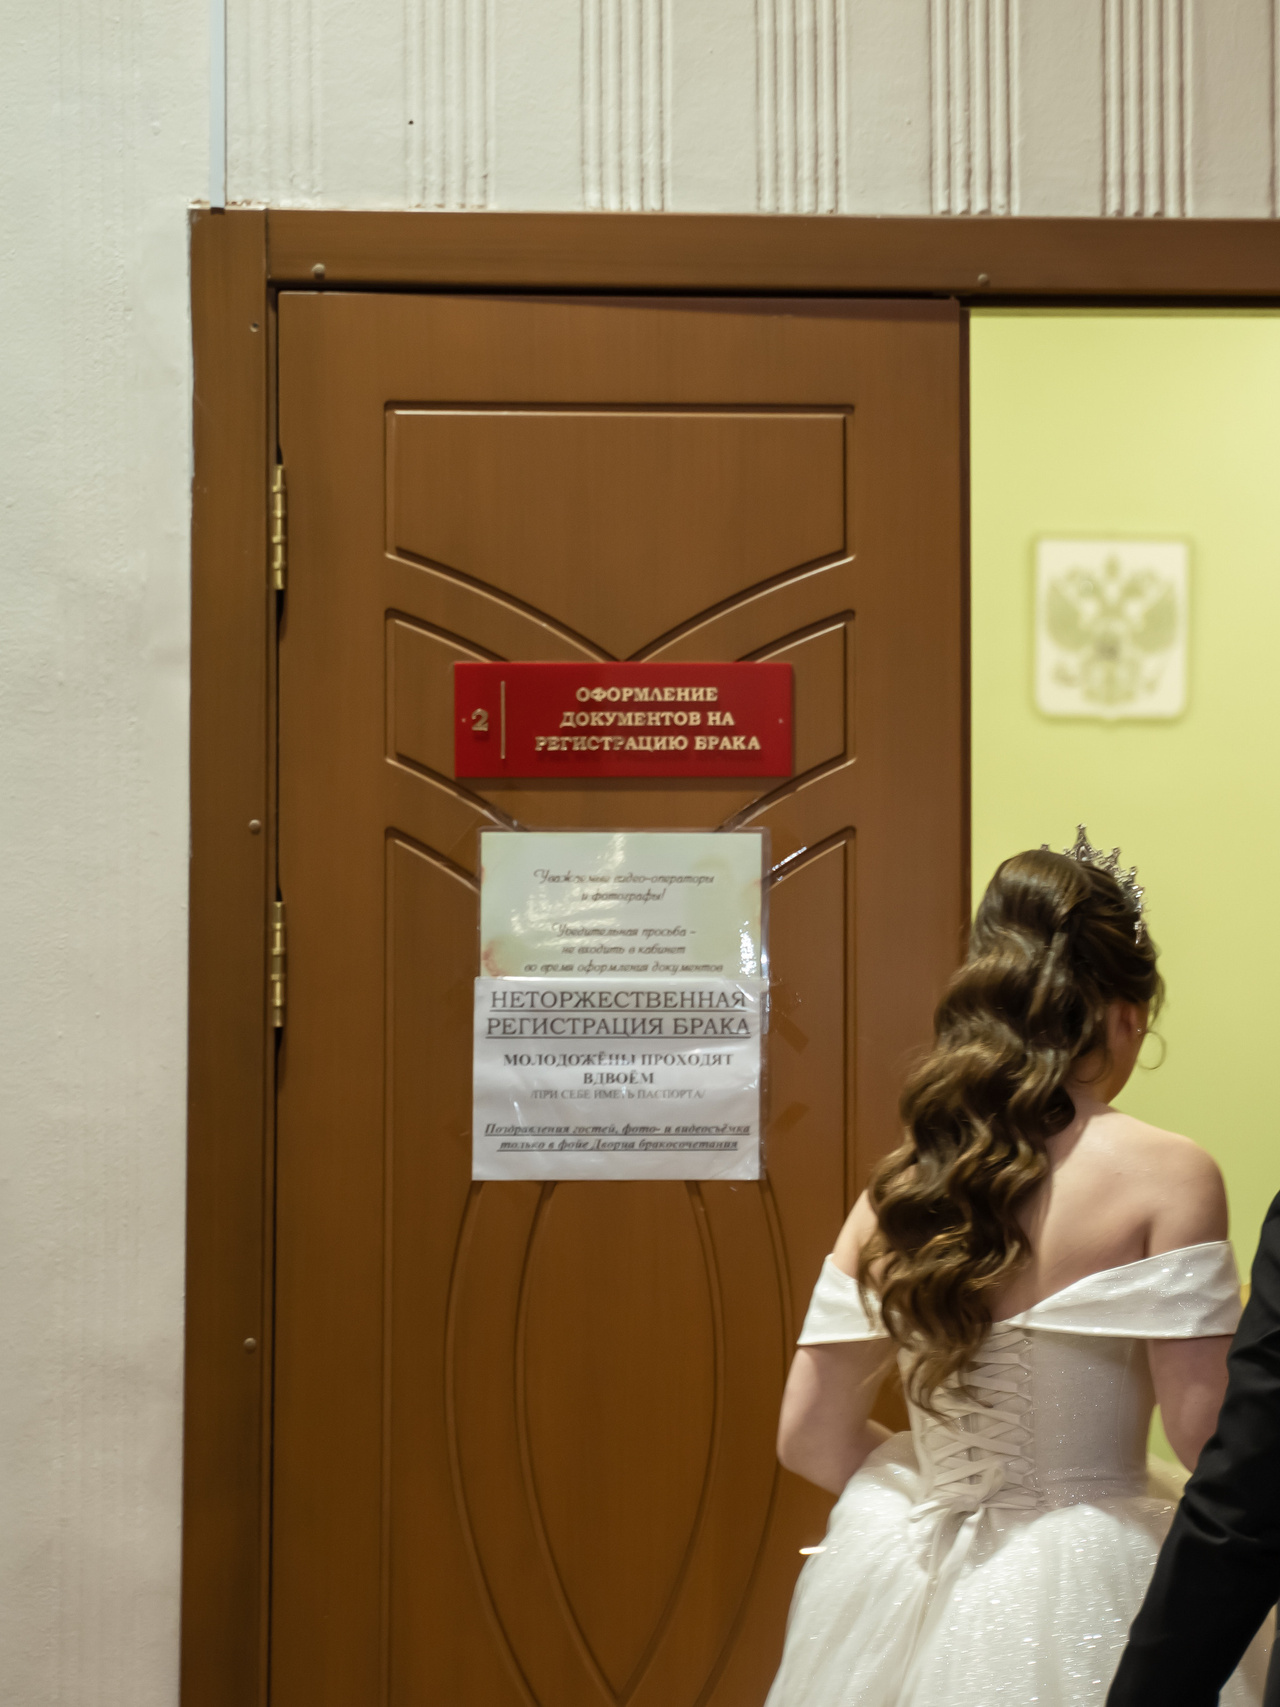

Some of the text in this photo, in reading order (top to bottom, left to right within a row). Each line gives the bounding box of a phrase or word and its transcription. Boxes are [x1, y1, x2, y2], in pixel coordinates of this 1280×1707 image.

[575, 687, 718, 702] ОФОРМЛЕНИЕ
[471, 708, 489, 732] 2
[559, 711, 735, 728] ДОКУМЕНТОВ НА
[535, 735, 761, 752] РЕГИСТРАЦИЮ БРАКА
[641, 926, 687, 939] просьба
[638, 943, 686, 954] кабинет
[651, 961, 724, 975] документов
[490, 990, 748, 1009] НЕТОРЖЕСТВЕННАЯ
[487, 1017, 751, 1036] РЕГИСТРАЦИЯ БРАКА
[641, 1053, 734, 1067] ПРОХОДЯТ
[583, 1072, 655, 1086] ВДВОЁМ
[484, 1123, 570, 1136] Поздравления
[638, 1138, 738, 1151] бракосочетания
